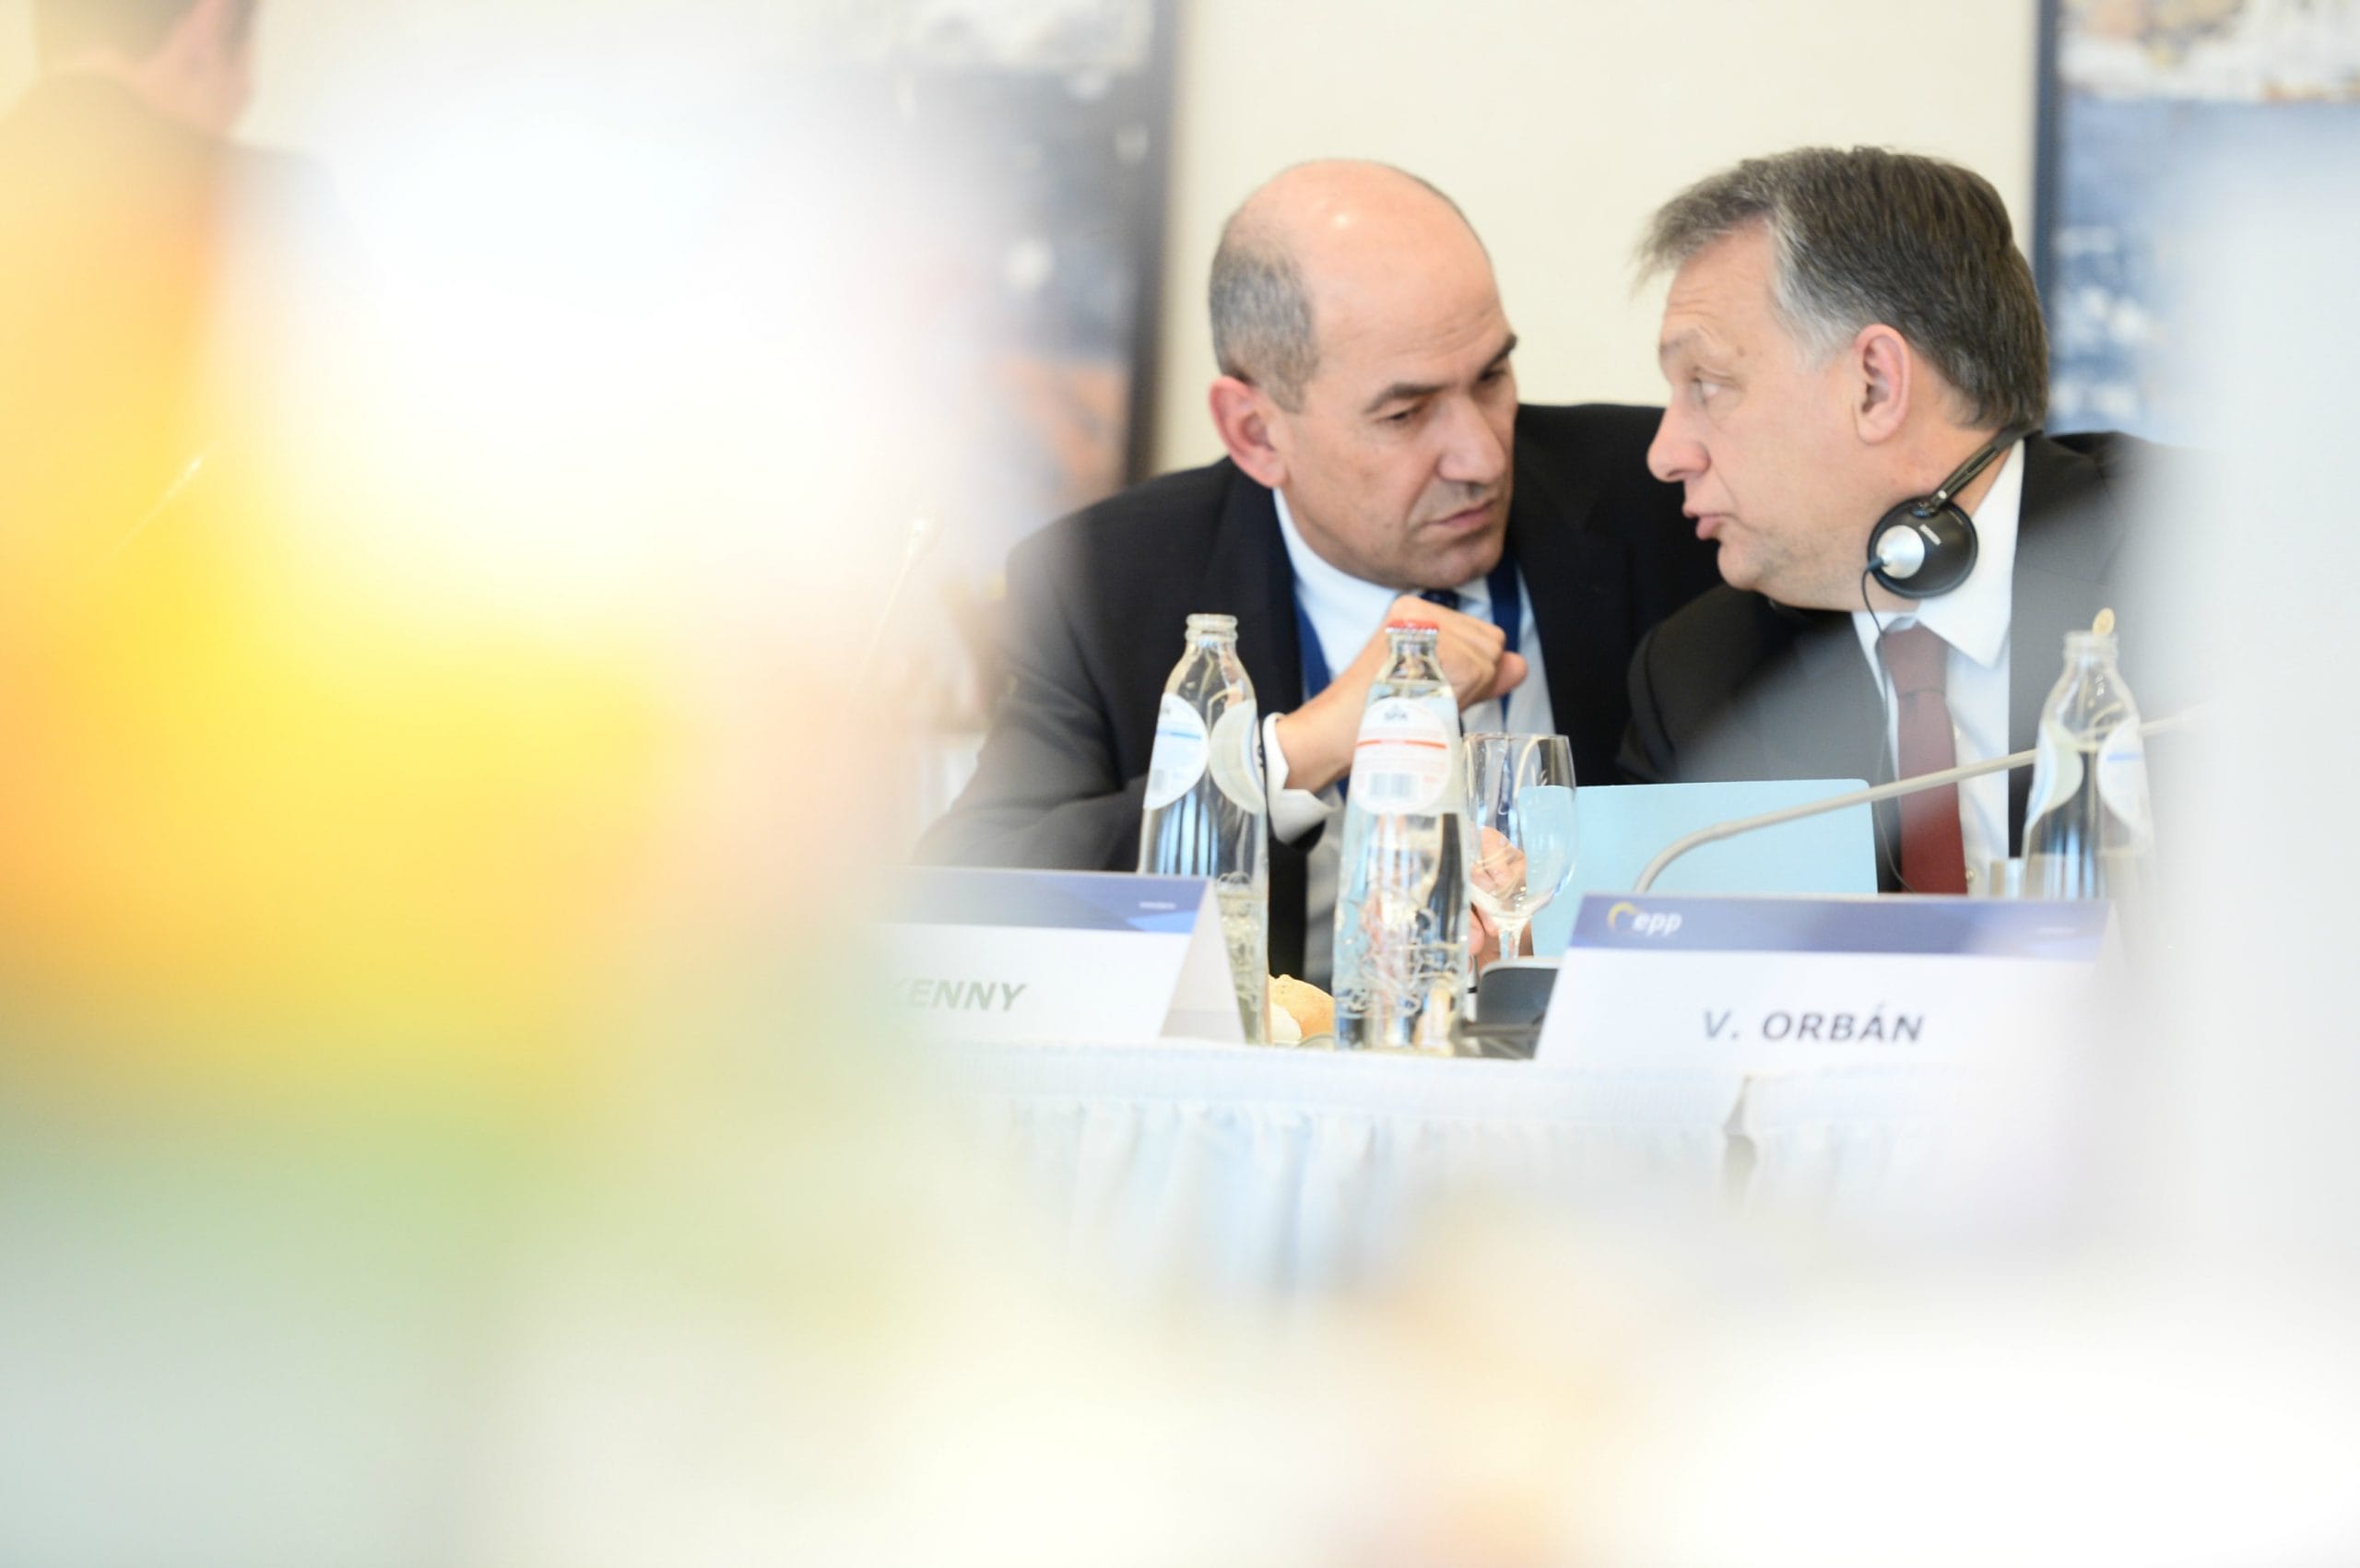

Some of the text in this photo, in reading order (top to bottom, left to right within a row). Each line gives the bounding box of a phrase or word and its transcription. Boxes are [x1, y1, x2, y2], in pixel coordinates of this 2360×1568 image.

[1633, 912, 1682, 937] epp
[1704, 1000, 1924, 1042] V. ORBÁN
